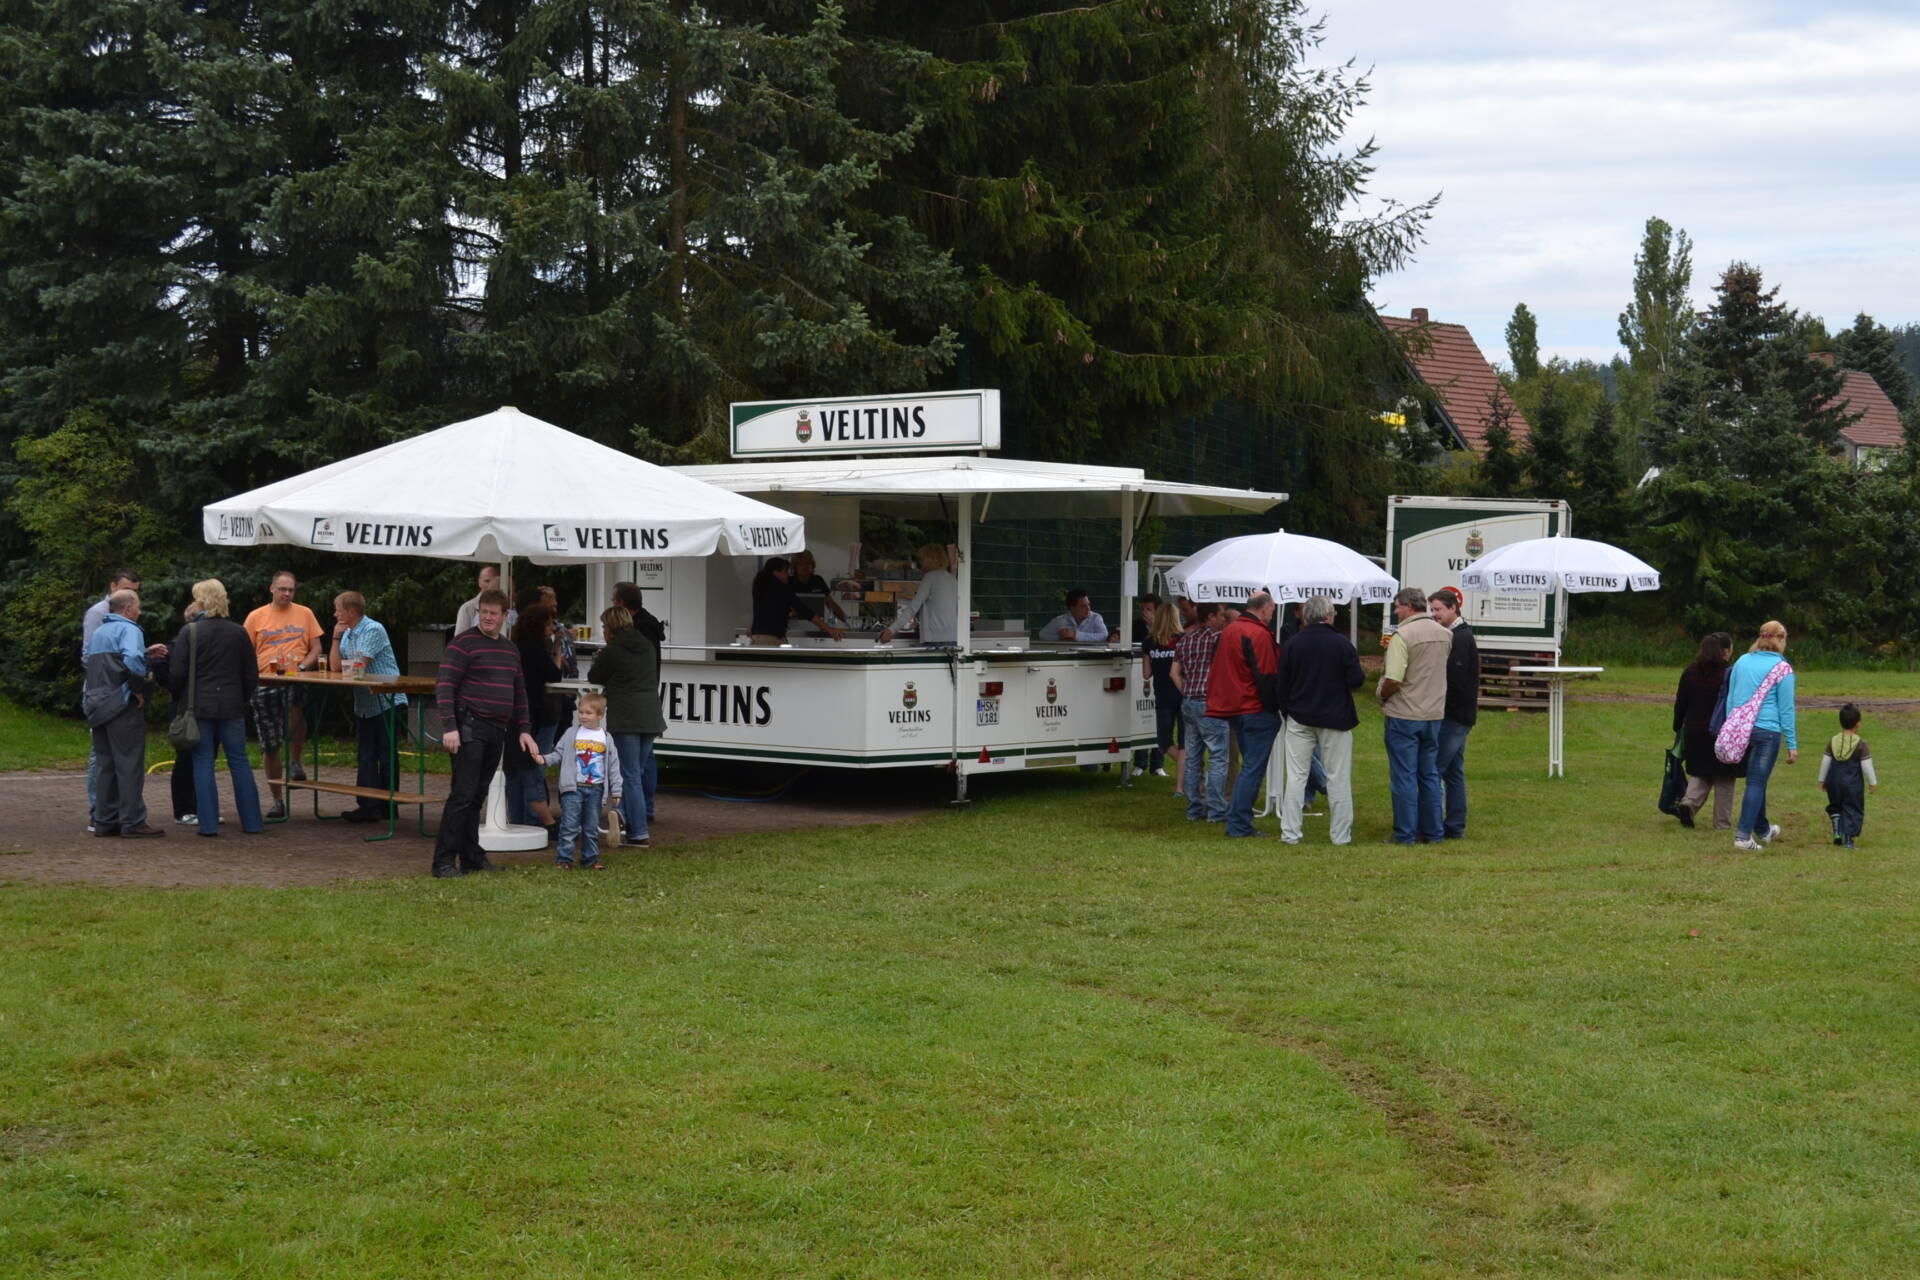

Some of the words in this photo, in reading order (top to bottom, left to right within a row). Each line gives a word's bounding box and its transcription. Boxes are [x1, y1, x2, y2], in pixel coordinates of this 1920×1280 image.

[820, 405, 926, 441] VELTINS
[345, 522, 433, 547] VELTINS
[574, 528, 669, 550] VELTINS
[750, 526, 788, 548] VELTINS
[640, 562, 663, 572] VELTINS
[1509, 574, 1547, 585] VELTINS
[1579, 576, 1618, 587] VELTINS
[981, 701, 995, 711] HSK
[1136, 699, 1156, 711] VELTIN
[888, 710, 931, 723] VELTINS
[985, 712, 998, 723] 181
[1035, 705, 1068, 718] VELTINS
